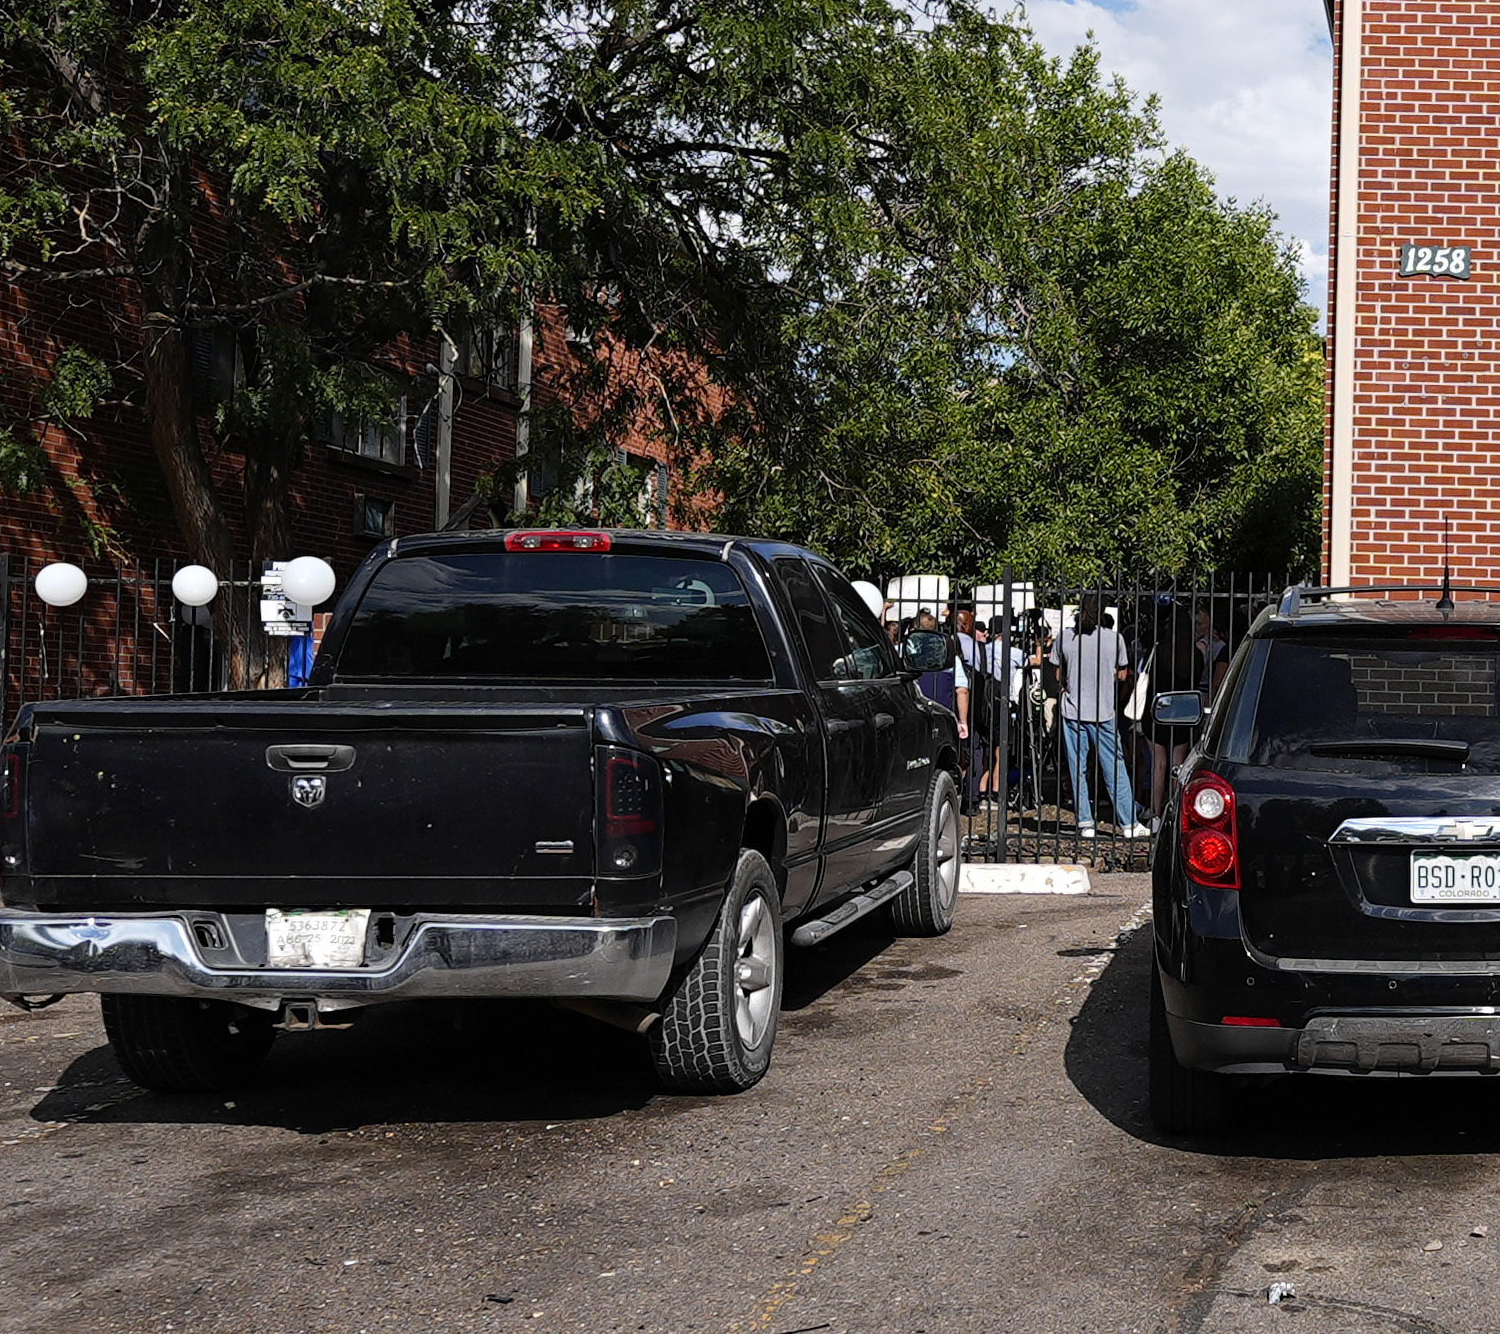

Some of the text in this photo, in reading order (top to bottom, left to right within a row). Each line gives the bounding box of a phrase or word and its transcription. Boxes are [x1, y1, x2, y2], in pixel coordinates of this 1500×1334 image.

[1405, 247, 1466, 274] 1258
[1438, 889, 1490, 898] COLORADO
[289, 921, 346, 932] 5363872
[307, 933, 321, 943] 25
